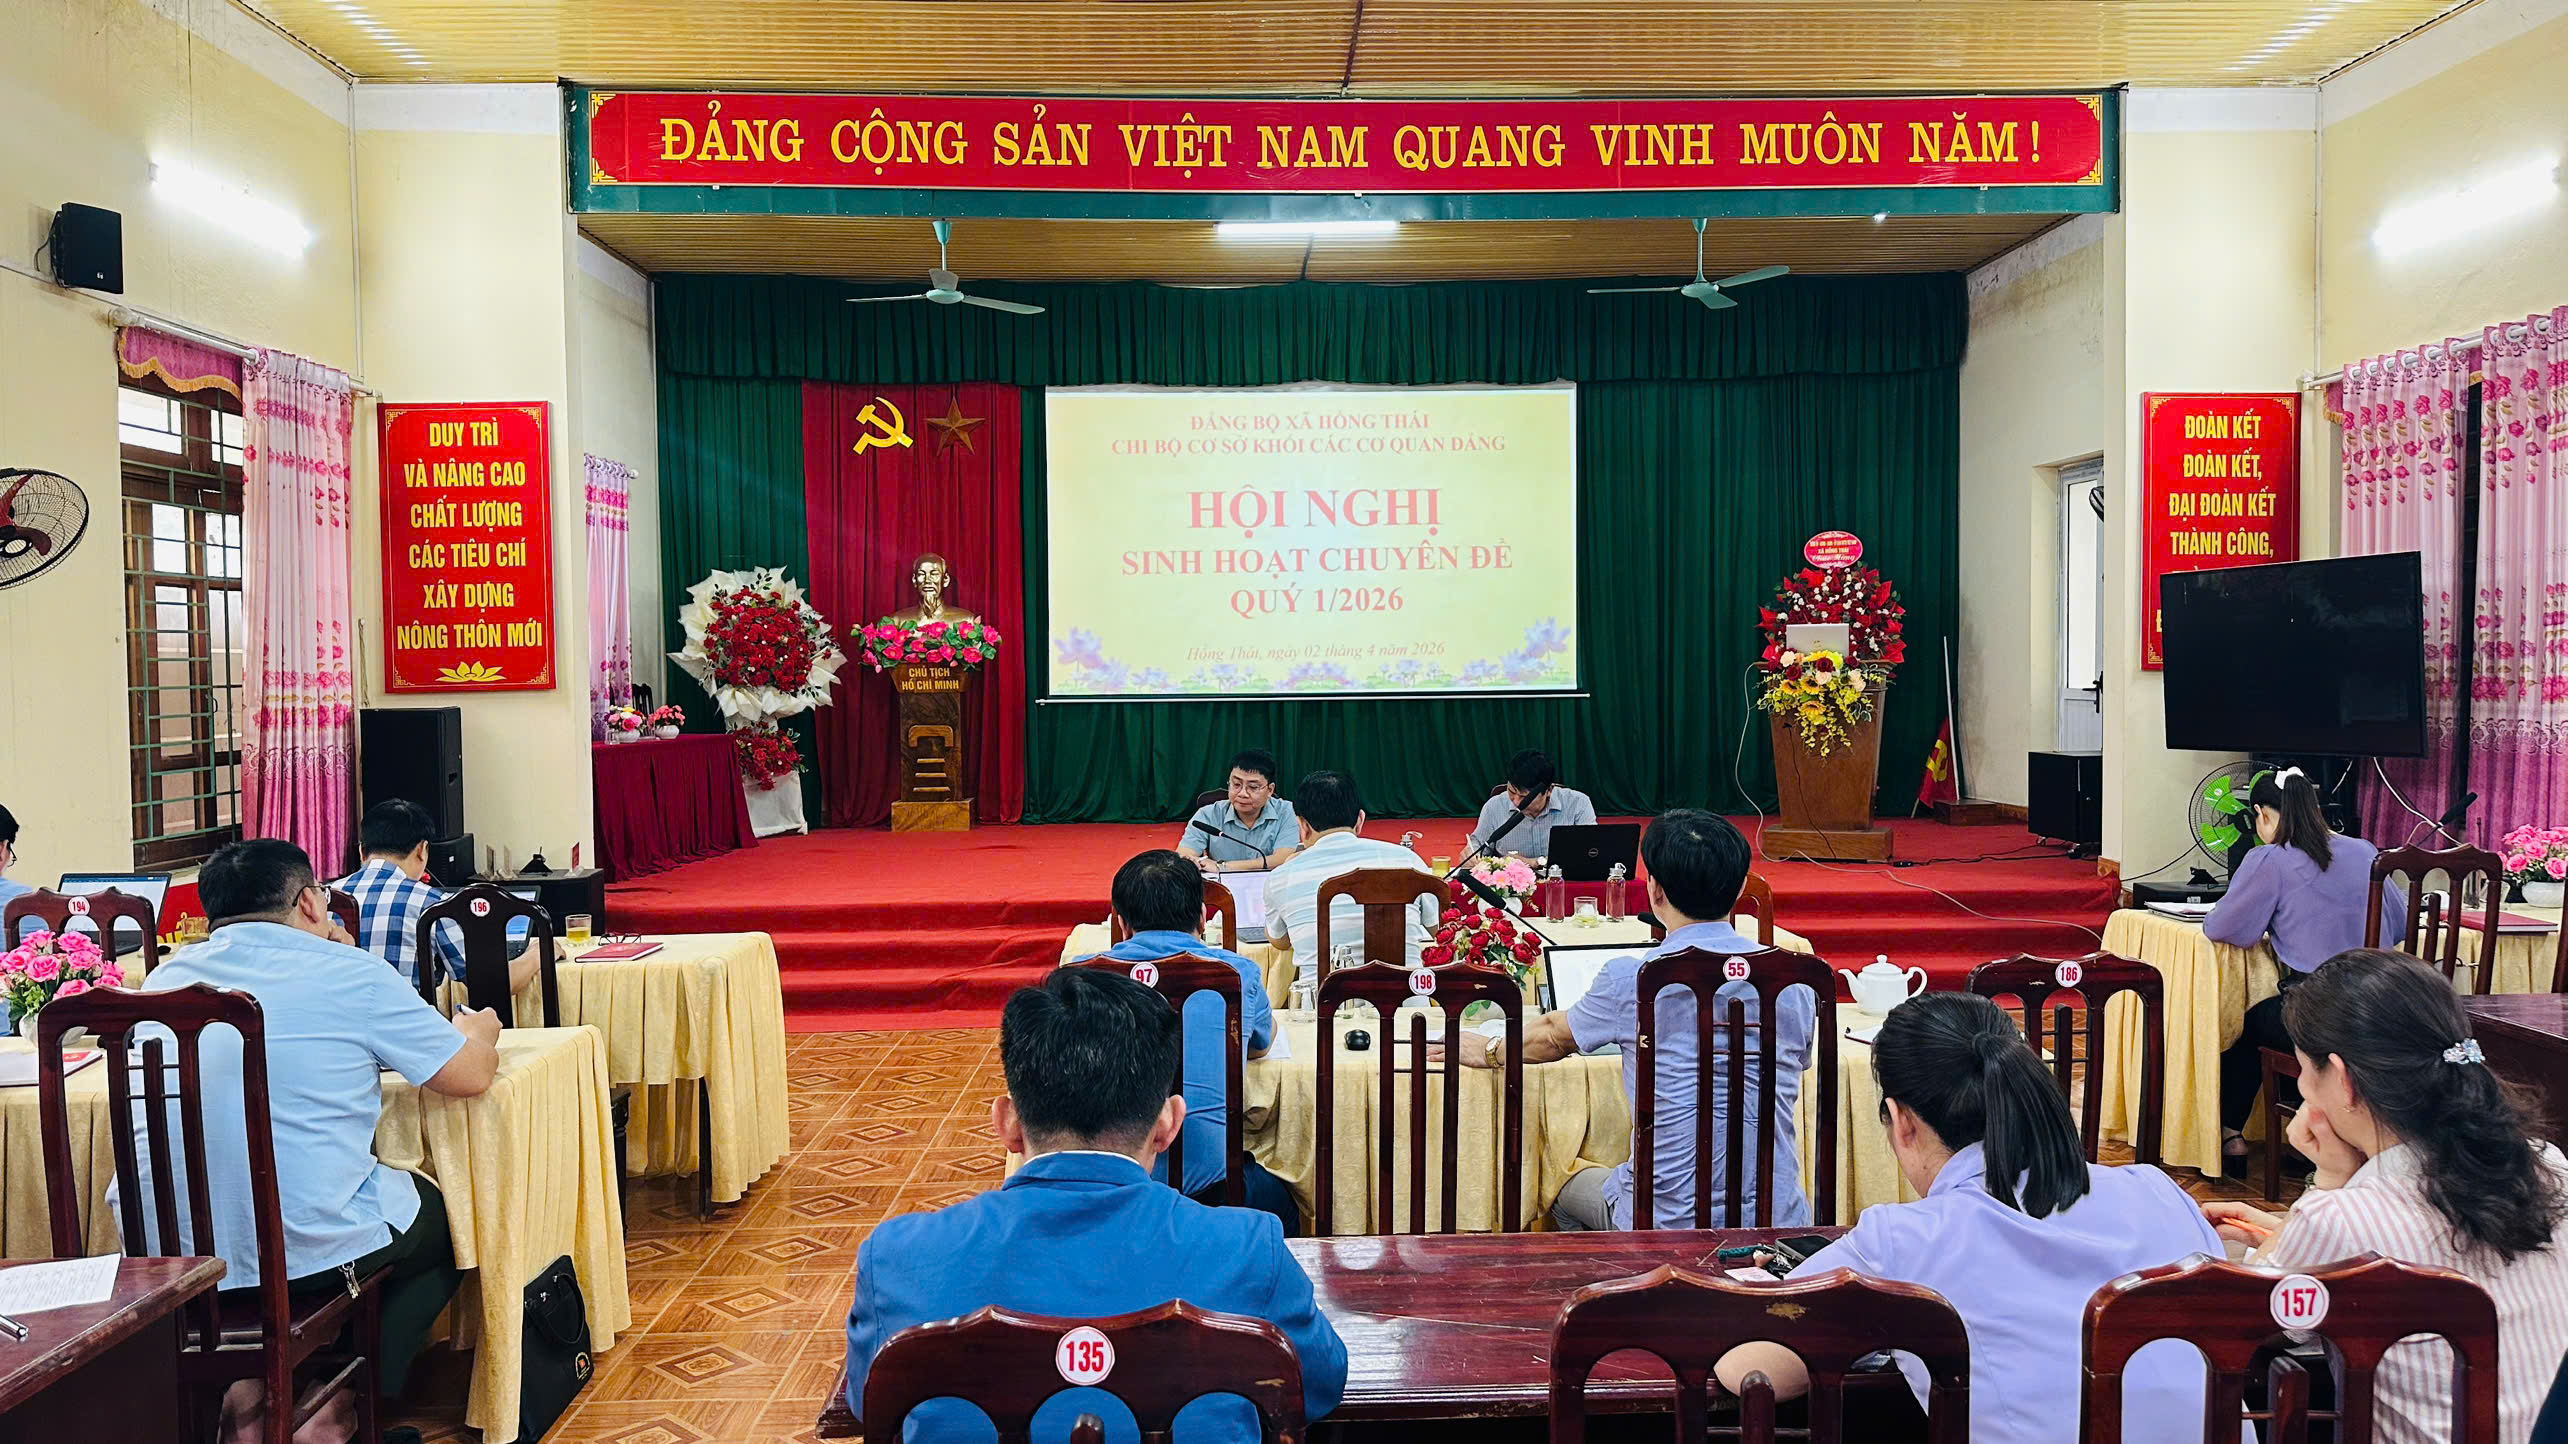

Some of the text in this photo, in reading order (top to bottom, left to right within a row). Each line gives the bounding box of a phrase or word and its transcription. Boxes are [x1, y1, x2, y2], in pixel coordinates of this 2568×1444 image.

[660, 99, 805, 164] ĐẢNG
[830, 107, 969, 176] CỘNG
[993, 103, 1092, 166] SẢN
[1118, 112, 1232, 179] VIỆT
[1256, 125, 1369, 169] NAM
[1393, 124, 1566, 172] QUANG
[1590, 124, 1714, 166] VINH
[1739, 111, 1883, 165] MUÔN
[429, 416, 499, 447] DUY TRÌ
[2184, 407, 2262, 439] ĐOÀN KẾT
[1111, 440, 1148, 454] CHI
[1155, 437, 1182, 458] BỘ
[1310, 434, 1351, 453] CÁC
[1389, 436, 1445, 454] QUAN
[403, 457, 526, 488] VÀ NÂNG CAO
[2183, 446, 2262, 481] ĐOÀN KẾT,
[410, 494, 523, 533] CHẤT LƯỢNG
[1186, 483, 1445, 540] HỘI NGHỊ
[2168, 485, 2277, 522] ĐẠI ĐOÀN KẾT
[408, 534, 527, 570] CÁC TIÊU CHÍ
[2170, 526, 2274, 558] THÀNH CÔNG,
[1121, 550, 1202, 577] SINH
[1214, 548, 1311, 580] HOẠT
[1318, 539, 1459, 573] CHUYÊN
[423, 579, 515, 613] XÂY DỰNG
[1229, 582, 1405, 620] QUÝ 1/2026
[397, 617, 543, 650] NÔNG THÔN MỚI
[1304, 645, 1321, 657] 02
[1366, 644, 1377, 656] 4
[1411, 642, 1447, 656] 2026
[909, 665, 950, 679] CHỦ TỊCH
[916, 679, 933, 689] CHÍ
[934, 680, 960, 689] MINH
[72, 901, 86, 912] 194
[473, 902, 487, 913] 196
[1135, 969, 1153, 983] 97
[1414, 974, 1433, 990] 198
[1728, 963, 1745, 977] 55
[2060, 966, 2078, 982] 186
[2280, 1287, 2317, 1317] 157
[1066, 1341, 1105, 1372] 135
